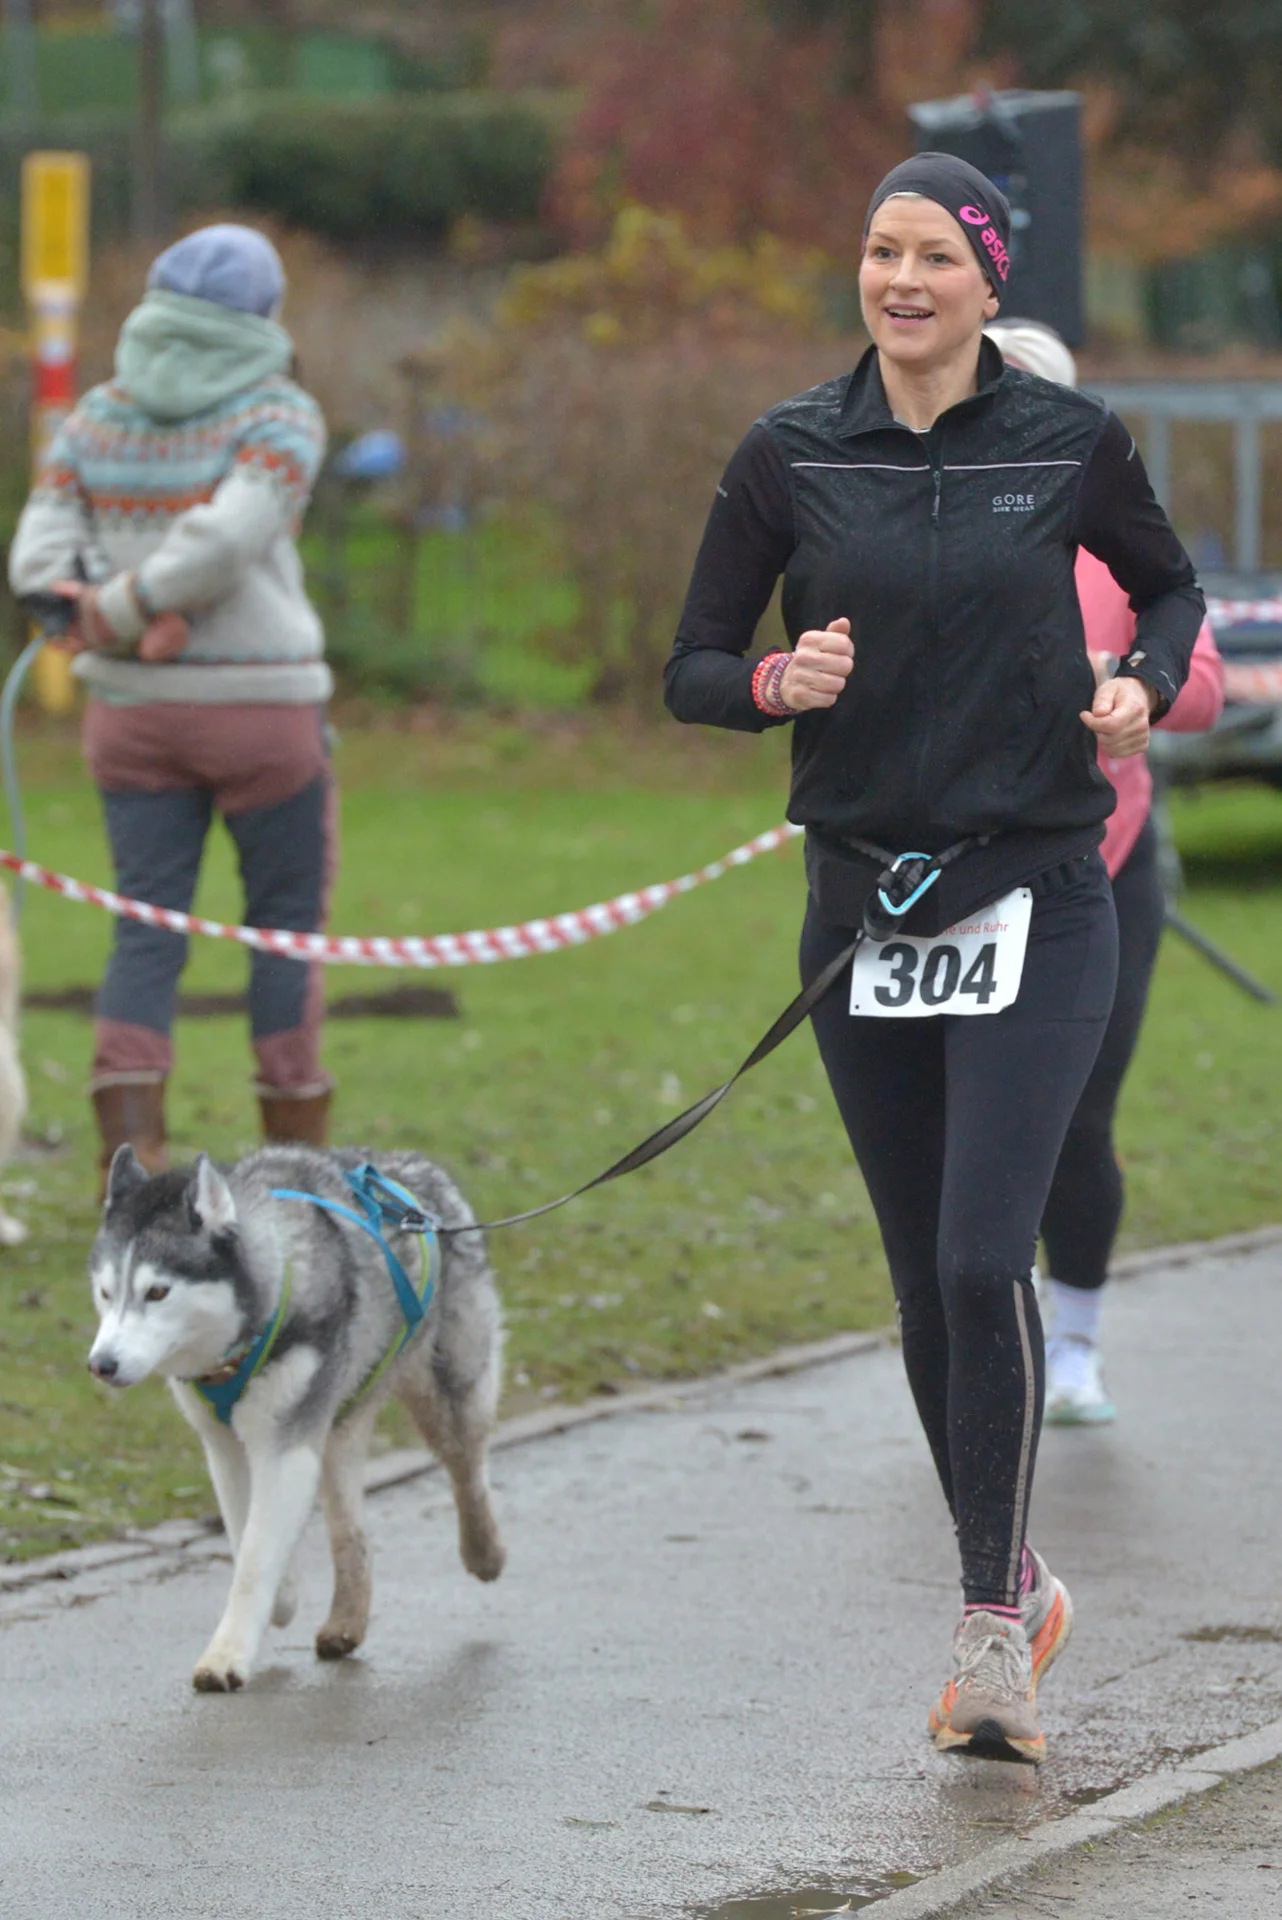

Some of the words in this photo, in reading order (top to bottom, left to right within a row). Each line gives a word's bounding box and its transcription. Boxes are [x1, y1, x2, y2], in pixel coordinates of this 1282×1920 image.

[992, 494, 1035, 505] GORE
[959, 922, 981, 935] und
[984, 920, 1009, 933] Ruhr
[873, 941, 998, 1008] 304
